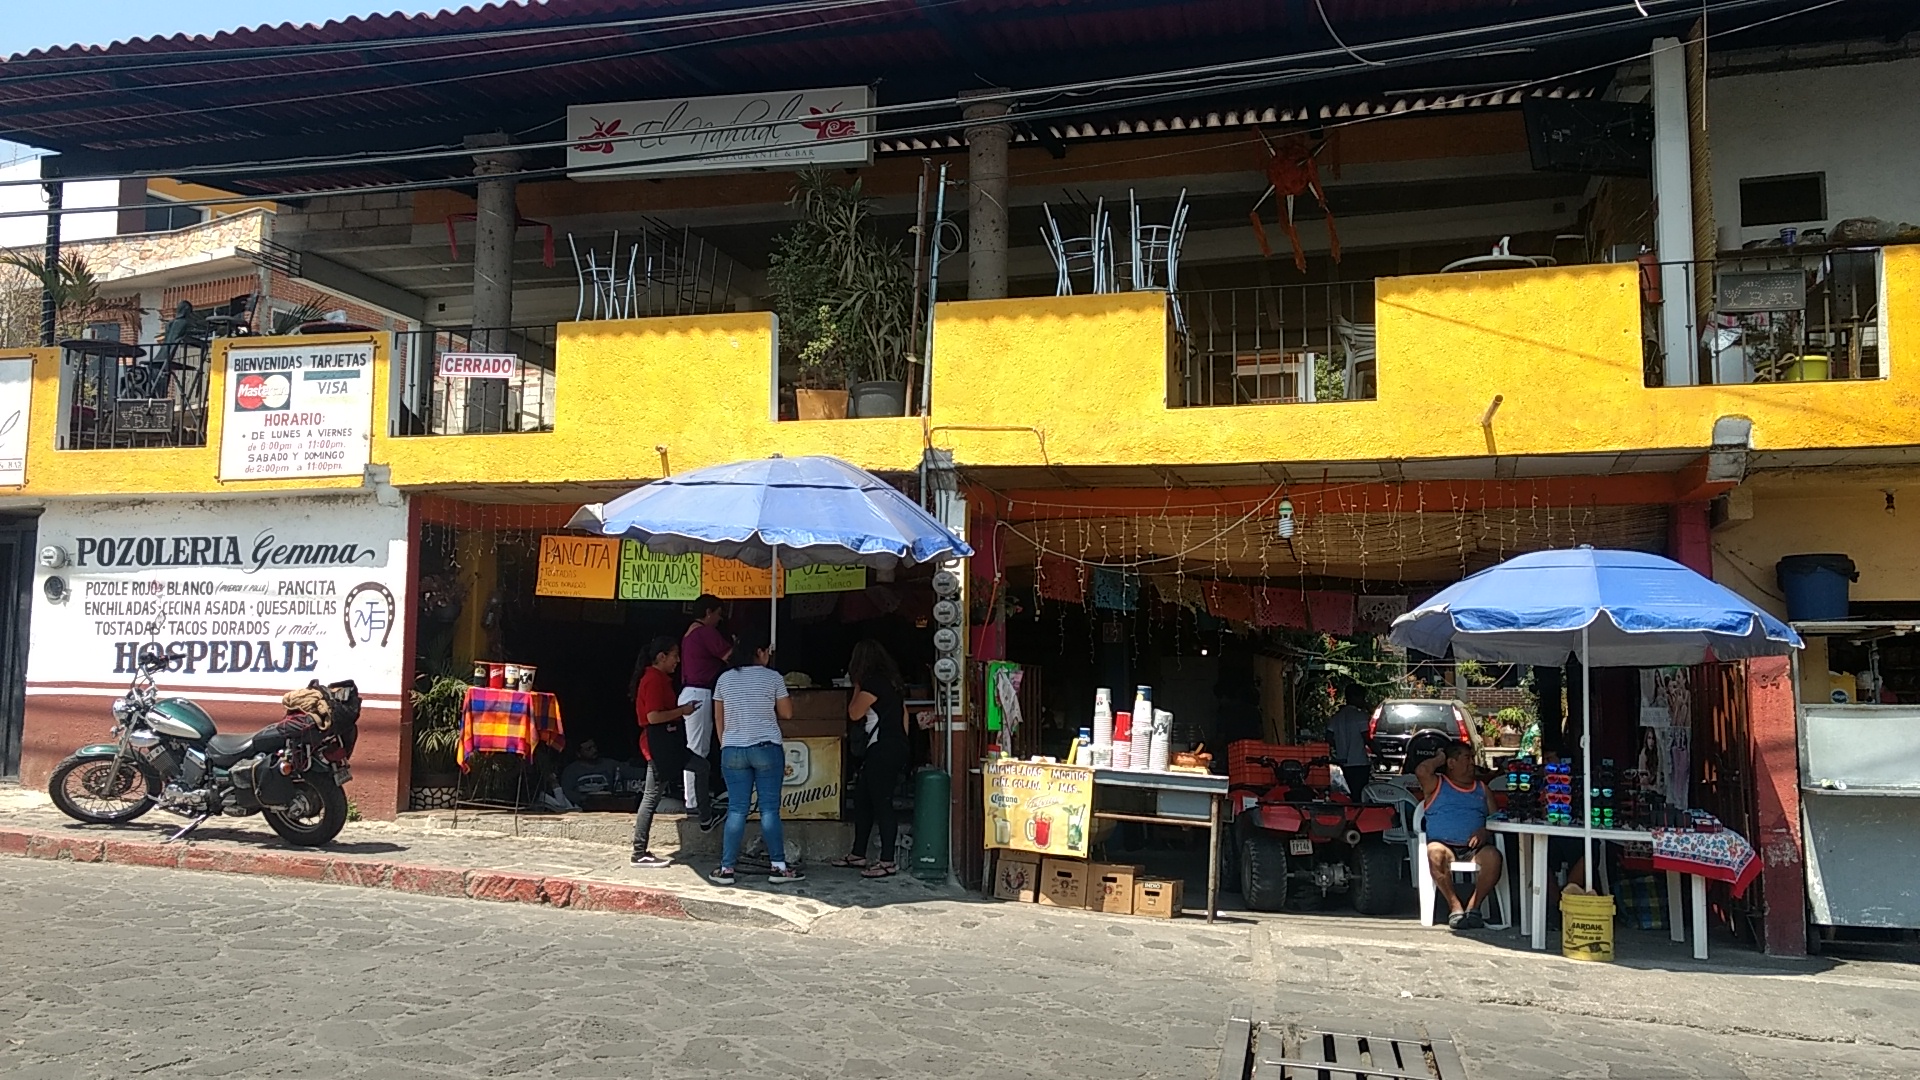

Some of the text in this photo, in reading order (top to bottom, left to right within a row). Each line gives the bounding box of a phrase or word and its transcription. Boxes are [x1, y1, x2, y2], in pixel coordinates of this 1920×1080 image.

[784, 149, 791, 157] &
[795, 149, 815, 157] BAR
[1750, 292, 1797, 306] BAR
[234, 353, 367, 372] BIENVENIDAS TARJETAS
[444, 357, 512, 374] CERRADO
[317, 380, 348, 395] VISA
[132, 414, 168, 429] BAR
[264, 412, 326, 427] HORARIO:
[251, 428, 353, 440] DE LUNES A VIERNES
[247, 442, 257, 452] de
[248, 451, 345, 463] SABADO Y DOMINGO
[244, 464, 255, 474] de
[256, 464, 290, 475] 2:00pm
[296, 464, 303, 472] a
[76, 528, 376, 574] POZOLERIA Gemma
[544, 537, 611, 570] PANCITA
[621, 561, 699, 588] ENMOLADAS
[710, 568, 753, 583] CECINA
[86, 581, 128, 596] POZOLE
[132, 581, 156, 596] ROJO
[167, 580, 214, 596] BLANCO
[277, 580, 337, 596] PANCITA
[620, 581, 669, 600] CECINA
[711, 584, 739, 596] CARNE
[84, 600, 337, 617] ENCHILADAS CECINA ASADA QUESADILLAS
[94, 620, 161, 636] TOSTADAS
[168, 620, 208, 636] TACOS
[212, 620, 270, 636] DORADOS
[274, 623, 287, 639] y
[112, 640, 319, 674] HOSPEDAJE
[987, 764, 1089, 781] MICHELADAS MOJITOS
[1047, 781, 1054, 791] Y
[990, 793, 1018, 804] Corona
[1571, 922, 1603, 931] BARDAHL
